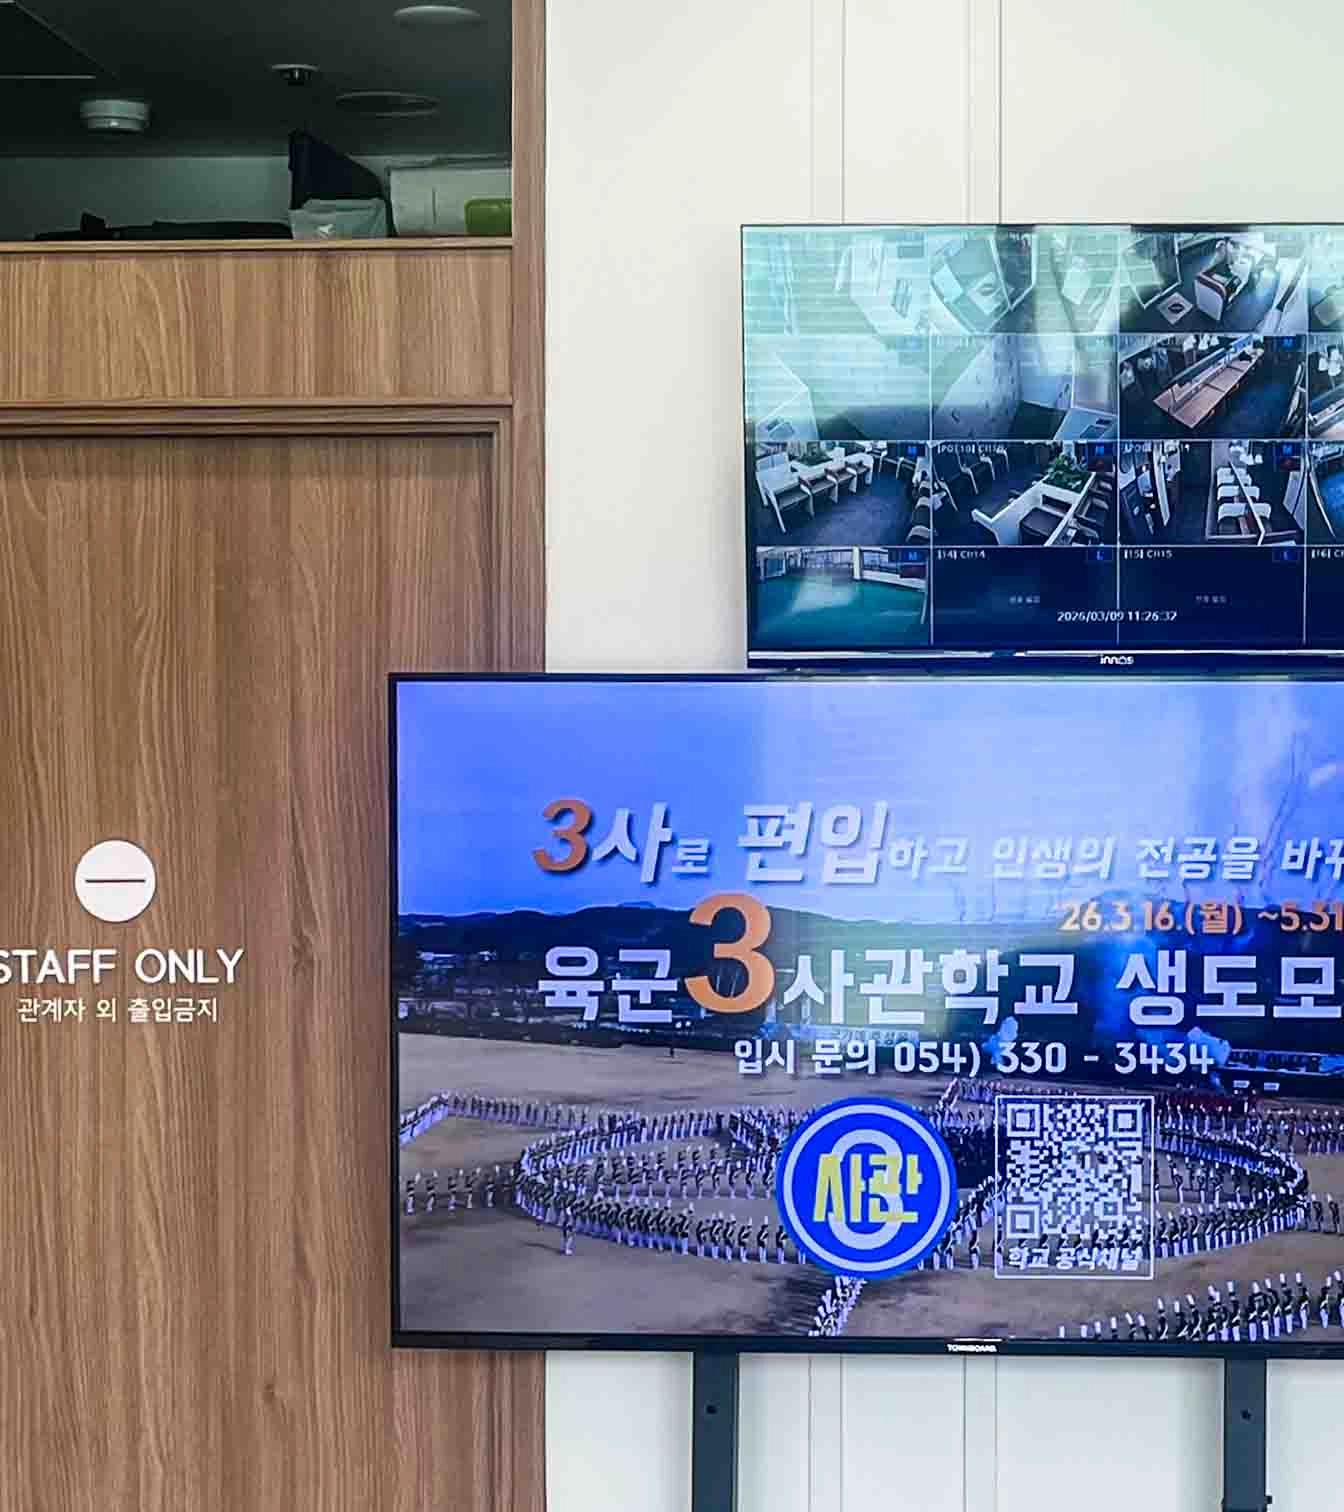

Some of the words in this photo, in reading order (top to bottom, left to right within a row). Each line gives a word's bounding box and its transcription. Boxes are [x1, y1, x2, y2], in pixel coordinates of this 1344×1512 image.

[533, 799, 711, 884] 3사로
[1135, 836, 1261, 881] 전공을
[135, 949, 244, 984] ONLY
[16, 998, 85, 1023] 관계자
[96, 998, 116, 1022] 외
[127, 998, 218, 1023] 출입금지
[734, 1040, 794, 1075] 입시
[812, 1040, 877, 1075] 문의
[894, 1041, 982, 1079] 054)
[998, 1042, 1067, 1076] 330
[1114, 1042, 1214, 1076] 3434
[1008, 1246, 1049, 1271] 학교
